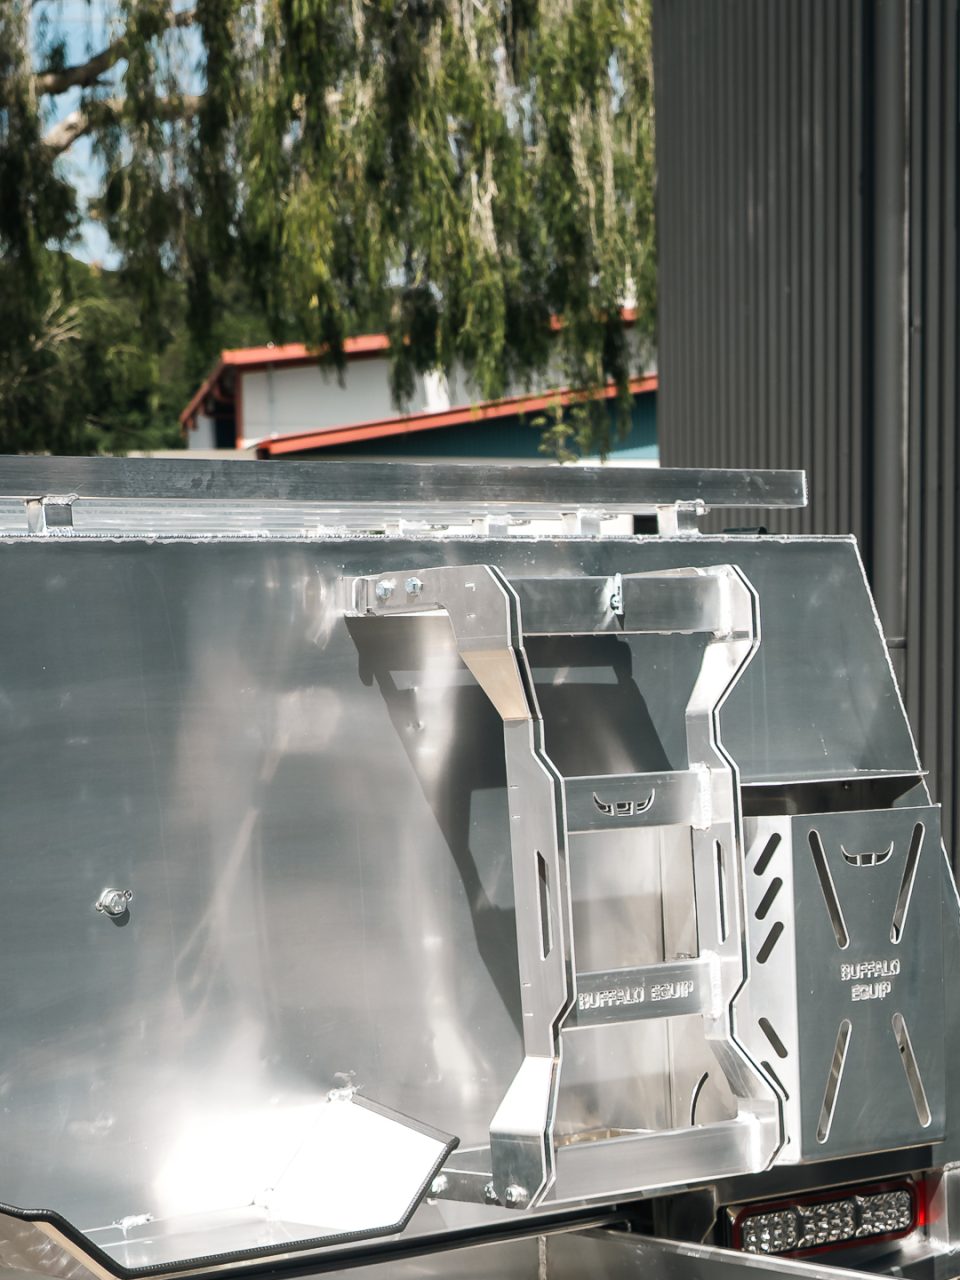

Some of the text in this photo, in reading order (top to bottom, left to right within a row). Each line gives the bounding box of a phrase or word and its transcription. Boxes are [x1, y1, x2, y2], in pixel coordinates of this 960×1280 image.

[841, 959, 900, 981] BUFFALO
[578, 980, 694, 1010] BUFFALO EQUIP
[851, 981, 891, 1001] EQUIP
